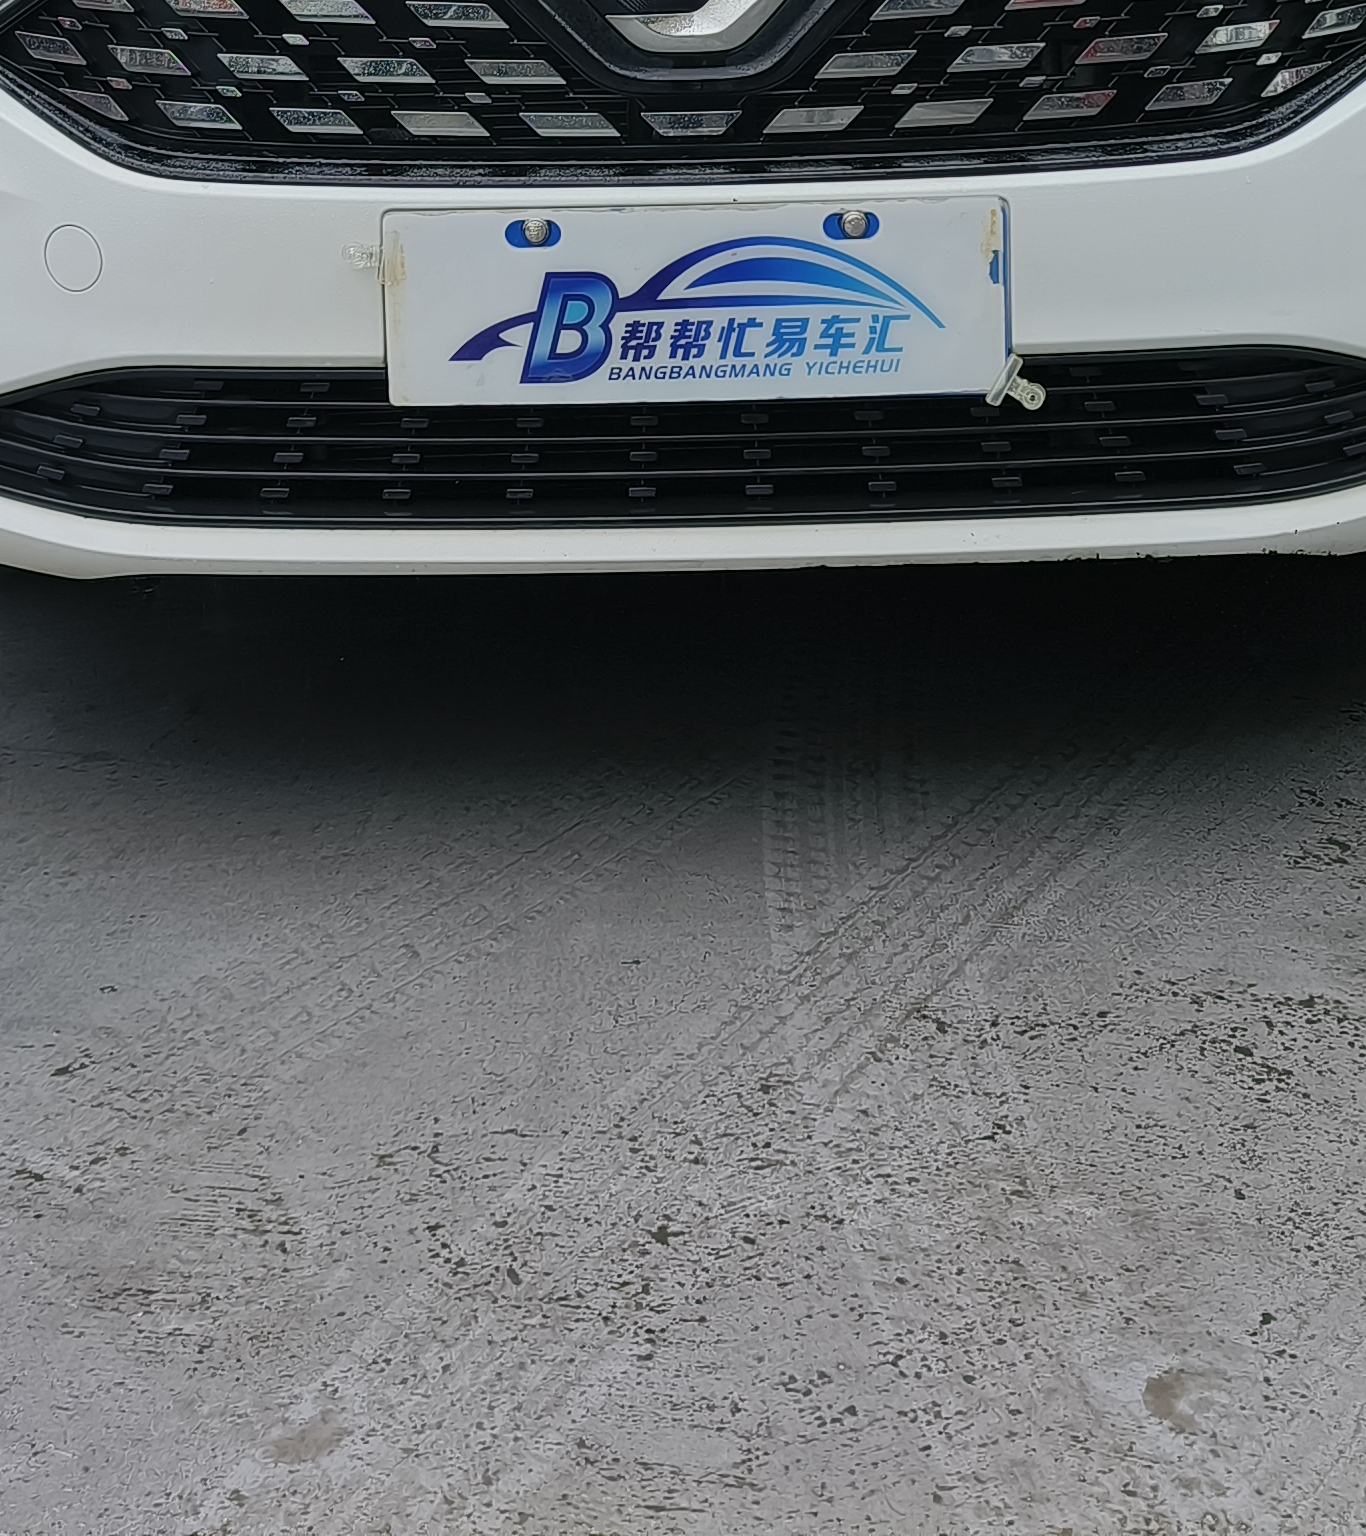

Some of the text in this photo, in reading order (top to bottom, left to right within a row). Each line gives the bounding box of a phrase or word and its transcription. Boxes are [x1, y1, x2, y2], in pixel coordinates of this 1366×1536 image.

[520, 271, 620, 384] B
[617, 313, 912, 363] 帮帮忙易车汇
[608, 358, 901, 381] BANGBANGMANG YICHEHUI
